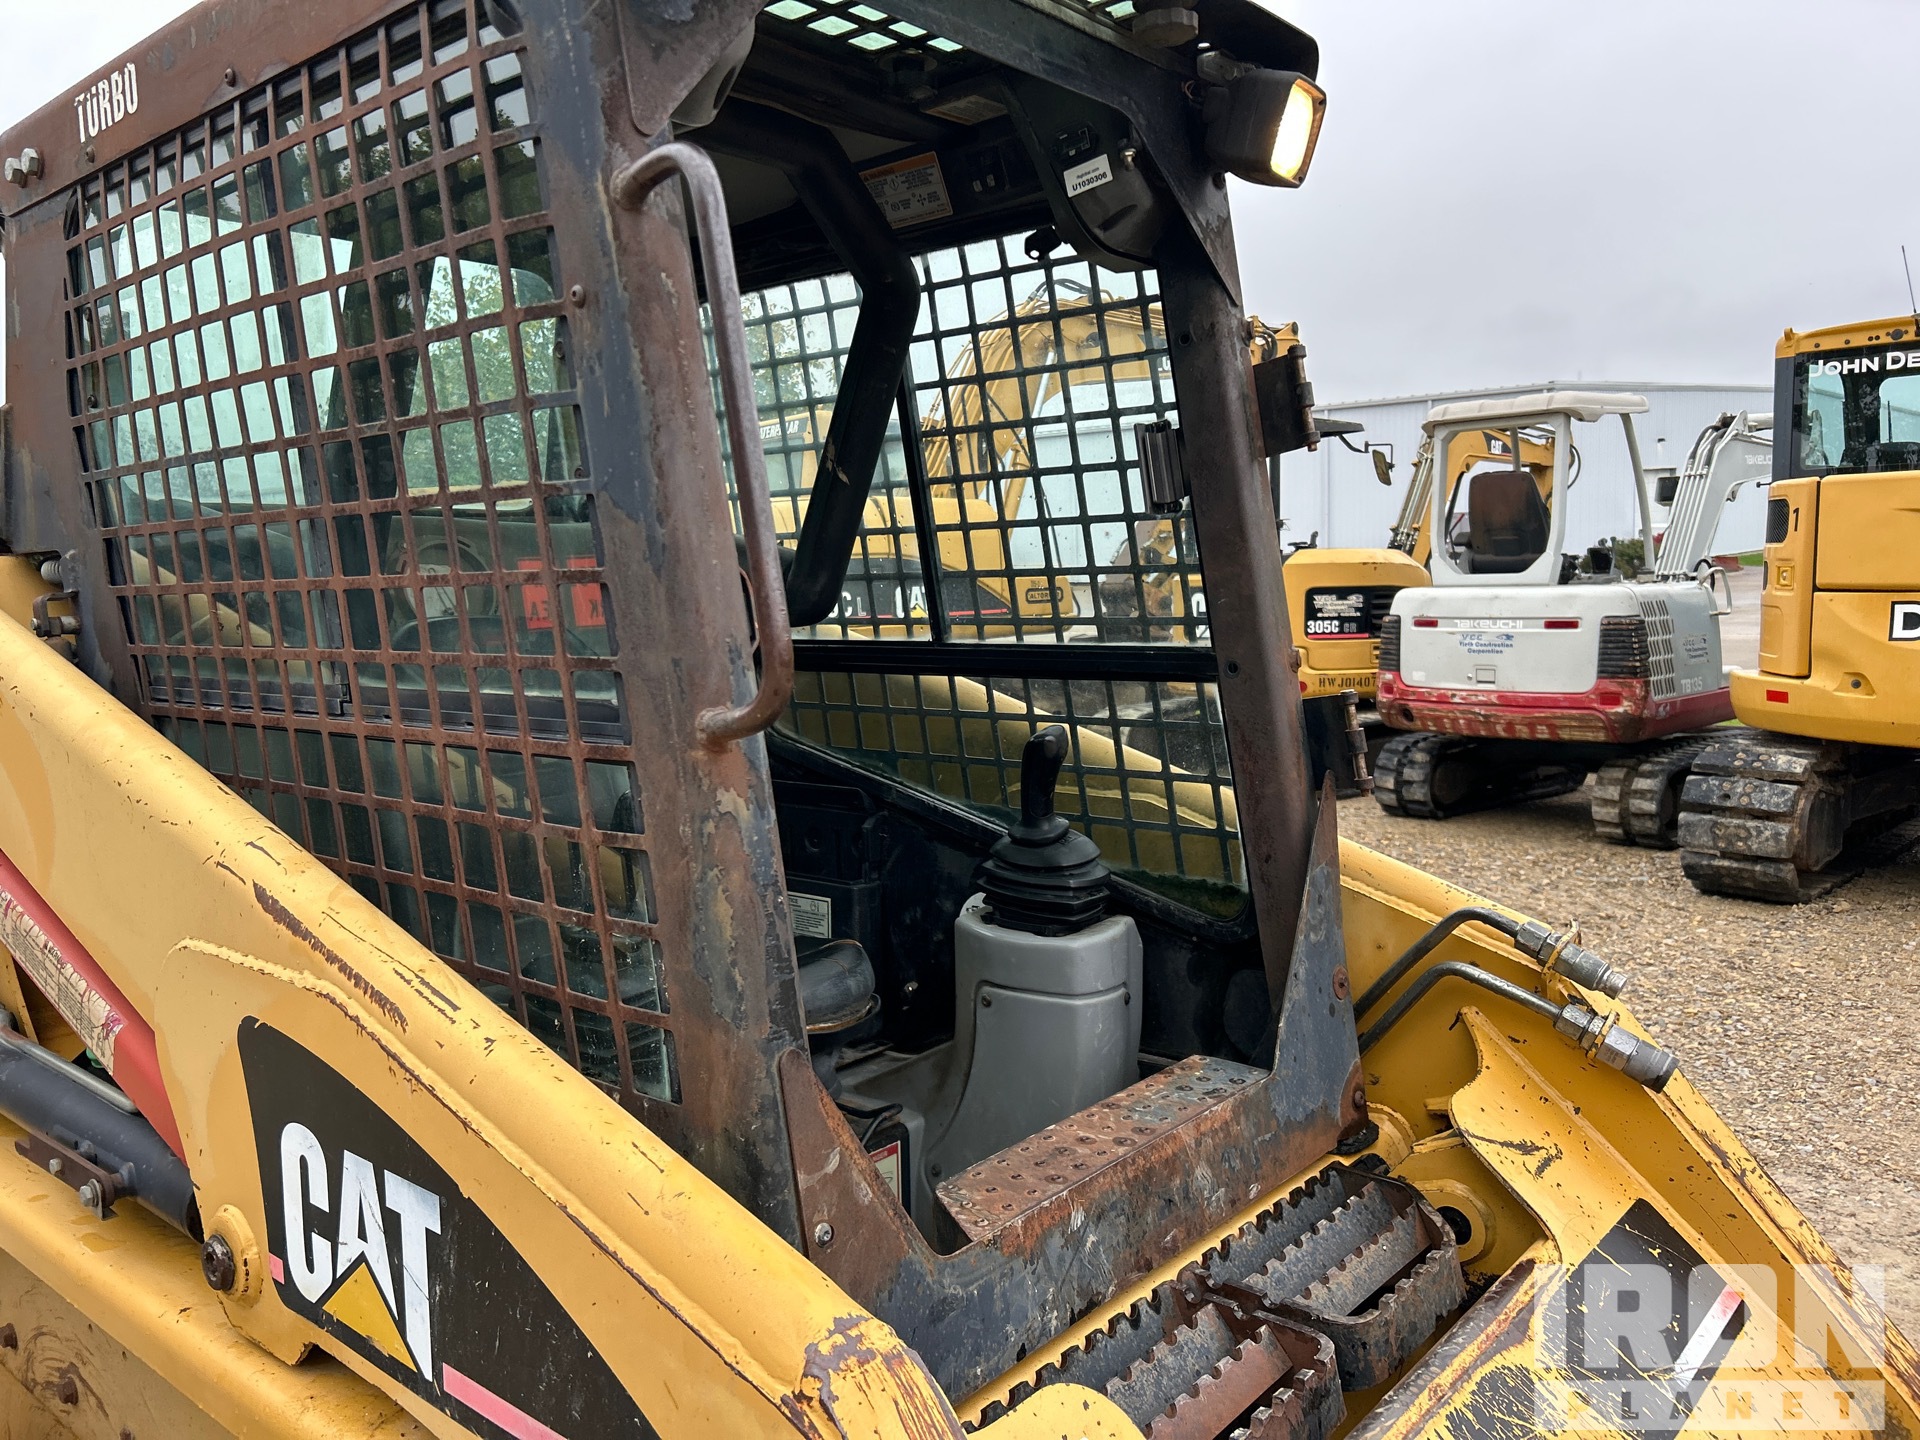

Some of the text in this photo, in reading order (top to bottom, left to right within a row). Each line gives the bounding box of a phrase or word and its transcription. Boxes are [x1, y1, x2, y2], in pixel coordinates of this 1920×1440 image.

[74, 62, 139, 143] TURBO
[1809, 357, 1879, 378] JOHN
[1491, 439, 1503, 454] CAT
[1744, 454, 1773, 465] TAKEUC
[1792, 507, 1800, 532] 1
[1307, 620, 1357, 634] 305C CR
[1454, 619, 1523, 629] TAKEUCHI
[1461, 633, 1483, 641] VCC
[1681, 676, 1703, 694] TB135
[281, 1122, 441, 1382] CAT
